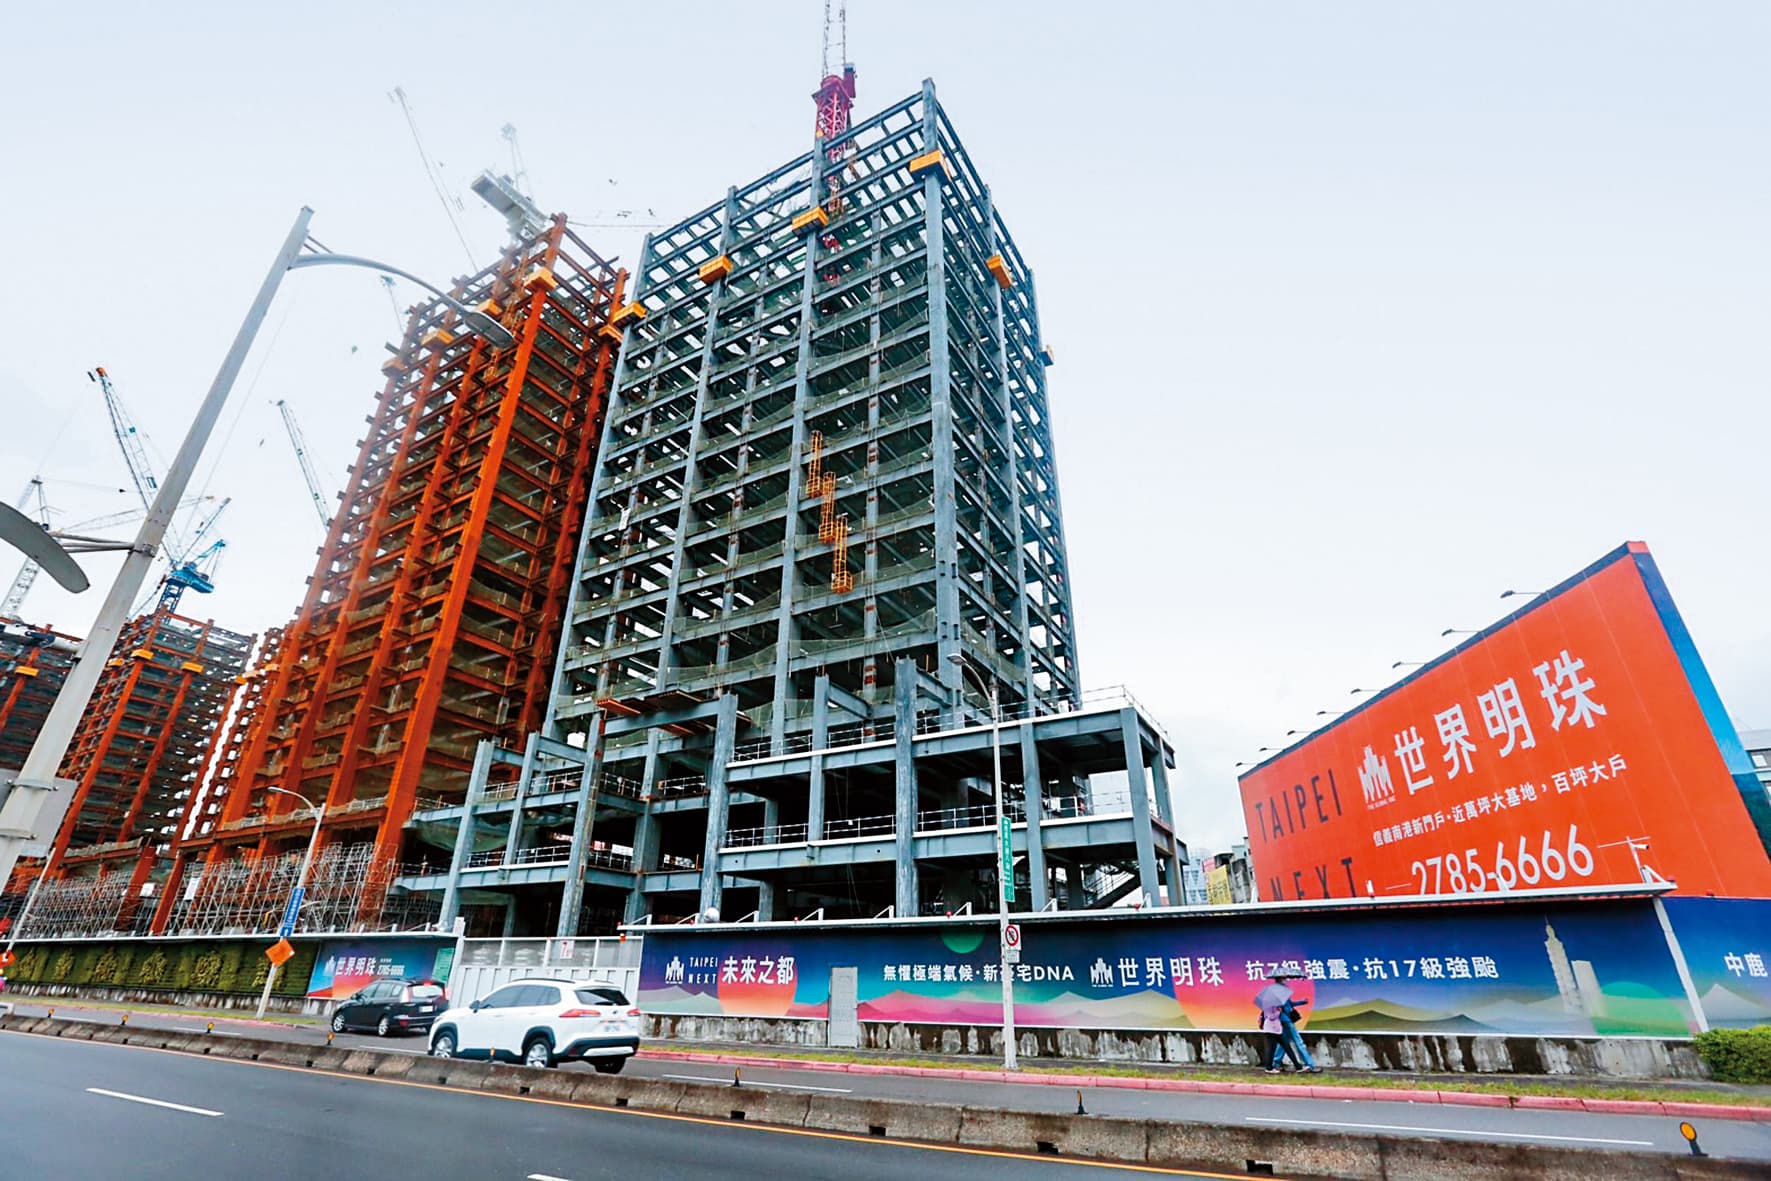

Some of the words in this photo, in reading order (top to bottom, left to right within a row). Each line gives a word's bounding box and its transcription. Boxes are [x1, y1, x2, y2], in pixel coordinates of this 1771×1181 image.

[1394, 649, 1607, 795] 世界明珠
[1255, 768, 1342, 844] TAIPEI
[1270, 856, 1357, 901] NEXT
[1411, 823, 1594, 896] 2785-6666
[688, 973, 717, 984] NEXT
[689, 956, 718, 968] TAIPEI
[721, 955, 795, 985] 未來之都
[1117, 956, 1224, 987] 世界明珠
